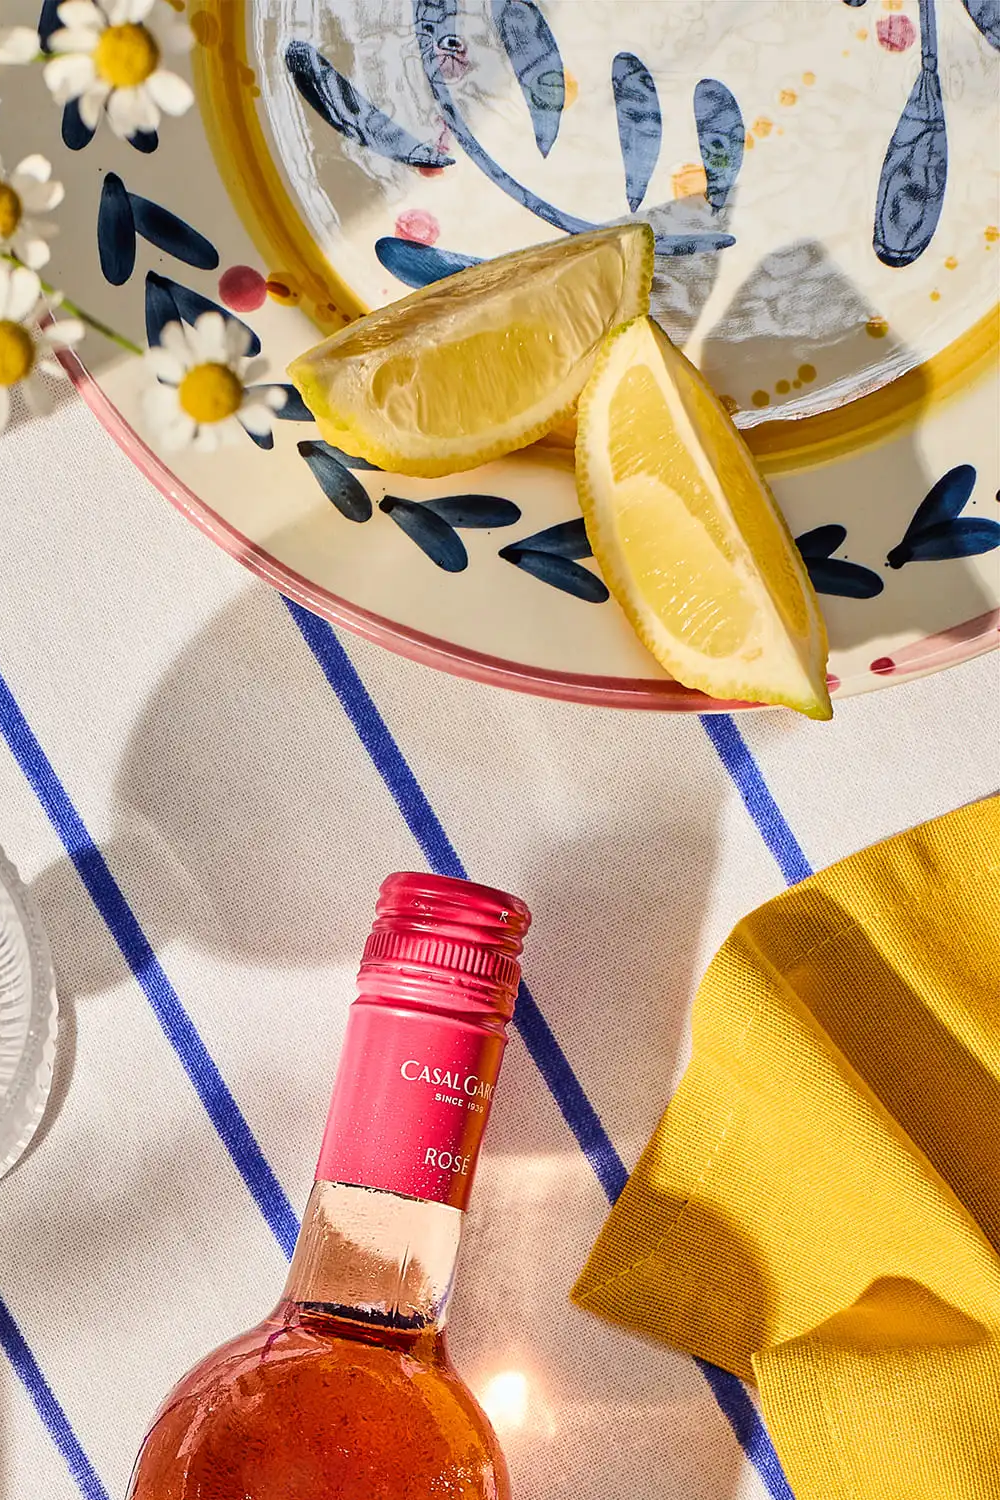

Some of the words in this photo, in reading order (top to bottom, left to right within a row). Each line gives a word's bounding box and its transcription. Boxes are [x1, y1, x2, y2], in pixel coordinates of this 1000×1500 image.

[400, 1060, 461, 1090] CASAL
[435, 1093, 464, 1107] SINCE
[467, 1102, 484, 1114] 1939
[424, 1147, 471, 1176] ROSÉ
